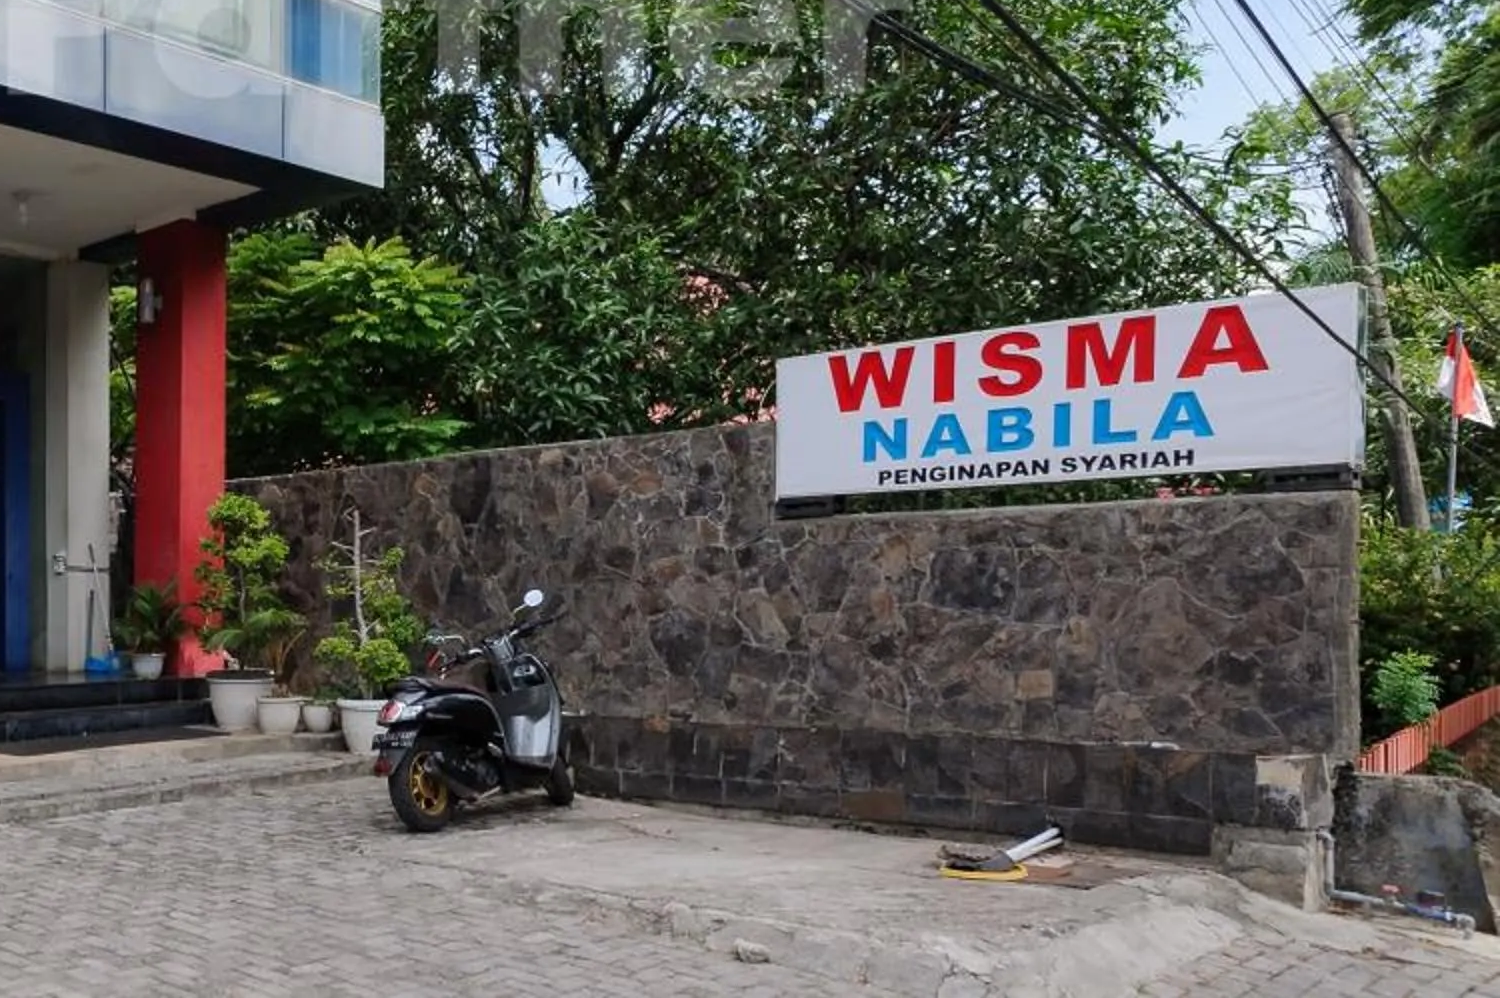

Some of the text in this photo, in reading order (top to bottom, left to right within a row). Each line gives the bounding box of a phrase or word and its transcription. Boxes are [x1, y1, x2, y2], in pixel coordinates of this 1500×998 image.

[828, 304, 1270, 413] WISMA
[862, 390, 1214, 463] NABILA
[877, 449, 1195, 486] PENGINAPAN SYARIAH
